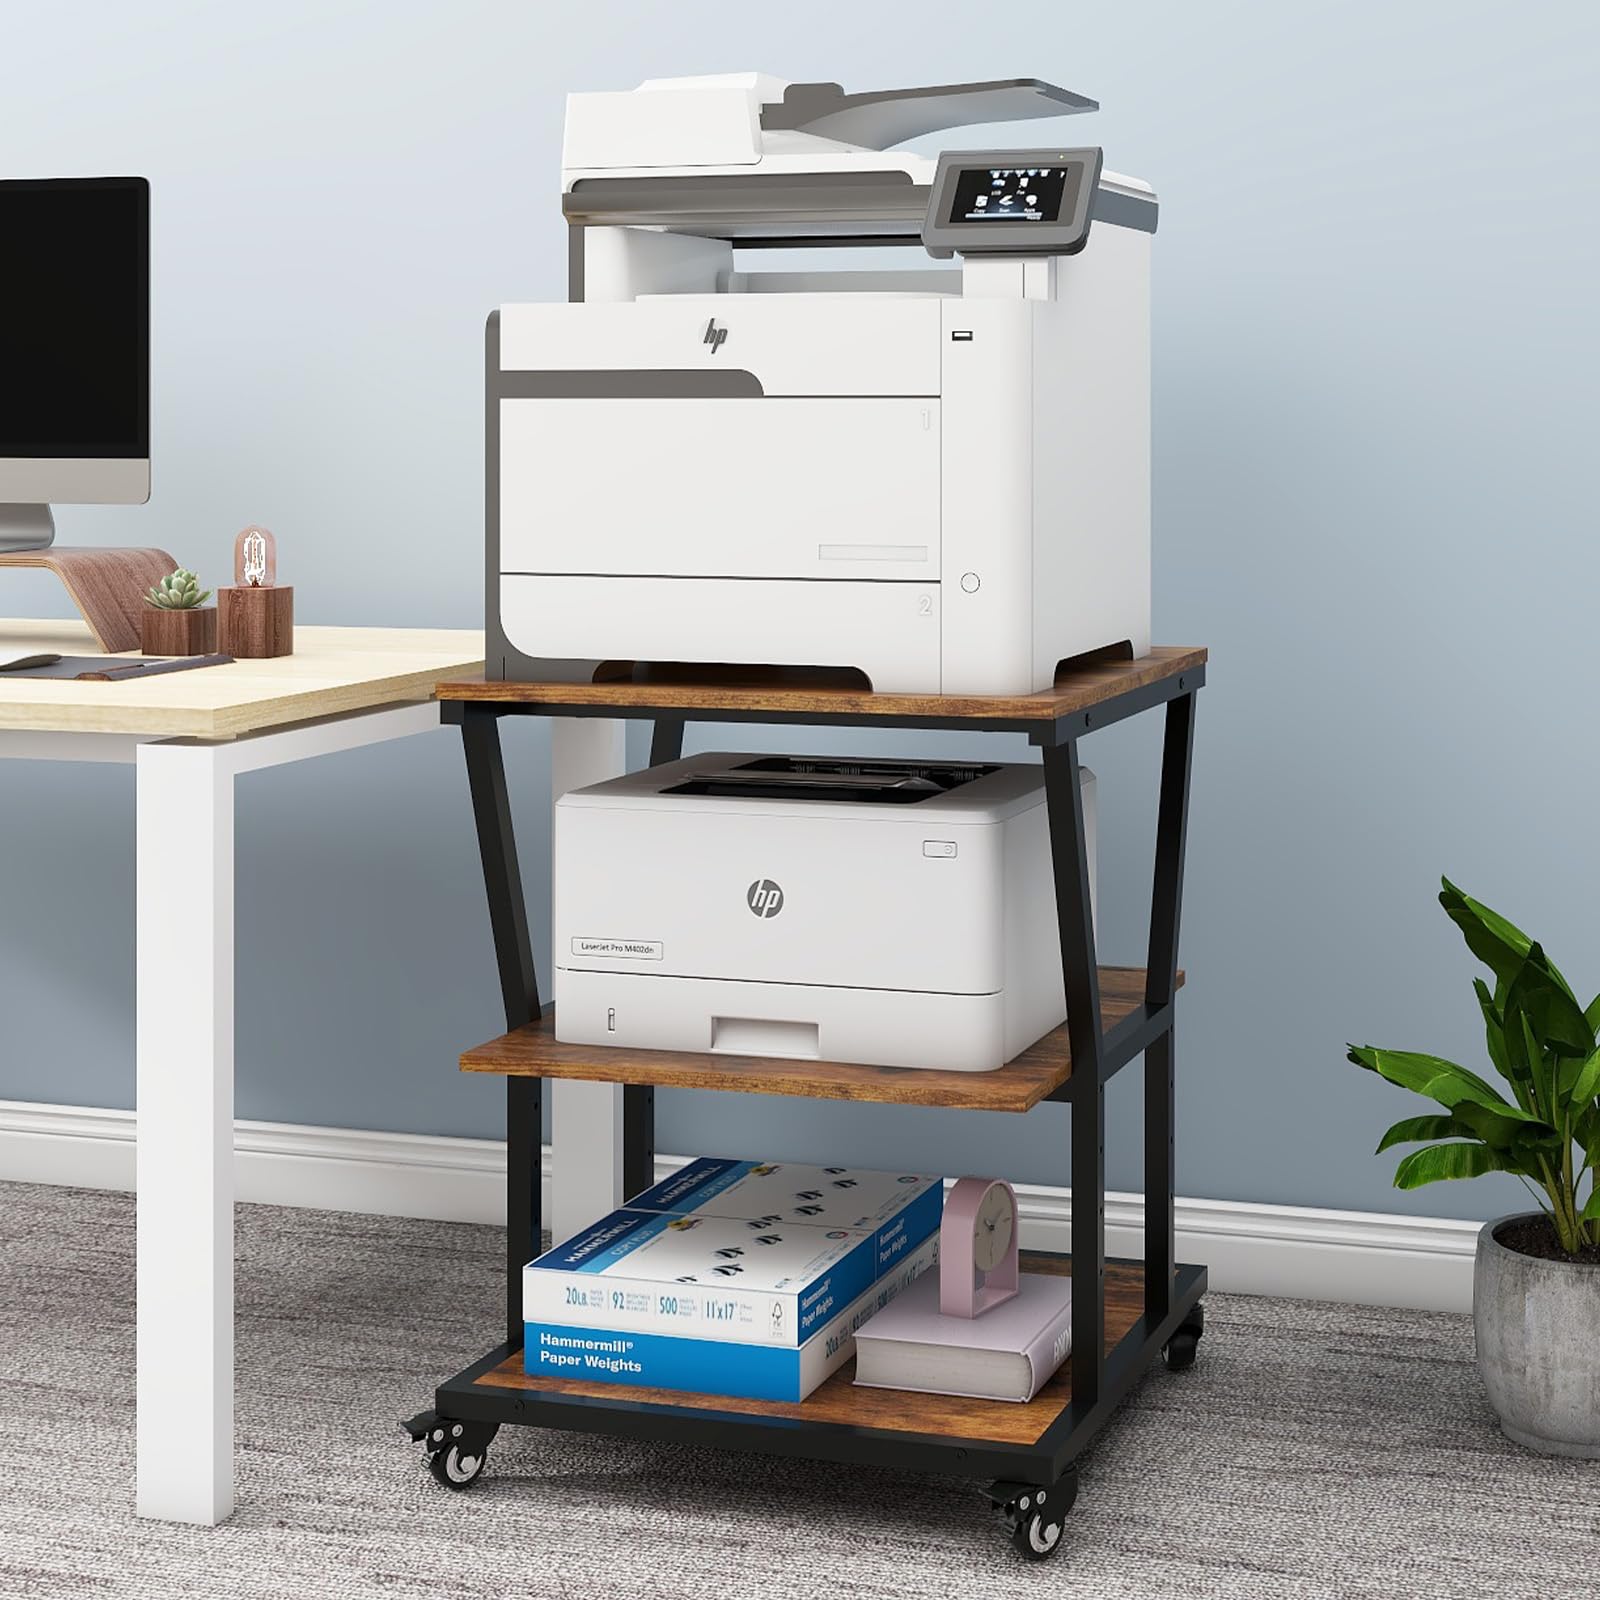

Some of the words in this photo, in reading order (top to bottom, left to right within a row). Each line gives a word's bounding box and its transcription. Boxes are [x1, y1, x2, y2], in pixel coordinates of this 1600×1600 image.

[703, 317, 729, 354] hp
[919, 593, 933, 616] 2
[750, 879, 781, 918] hp
[611, 943, 623, 952] Pro
[563, 1218, 640, 1263] HAMMERMILL
[612, 1291, 625, 1310] 92
[659, 1296, 678, 1315] 500
[540, 1350, 581, 1367] Paper
[584, 1354, 642, 1373] Weights
